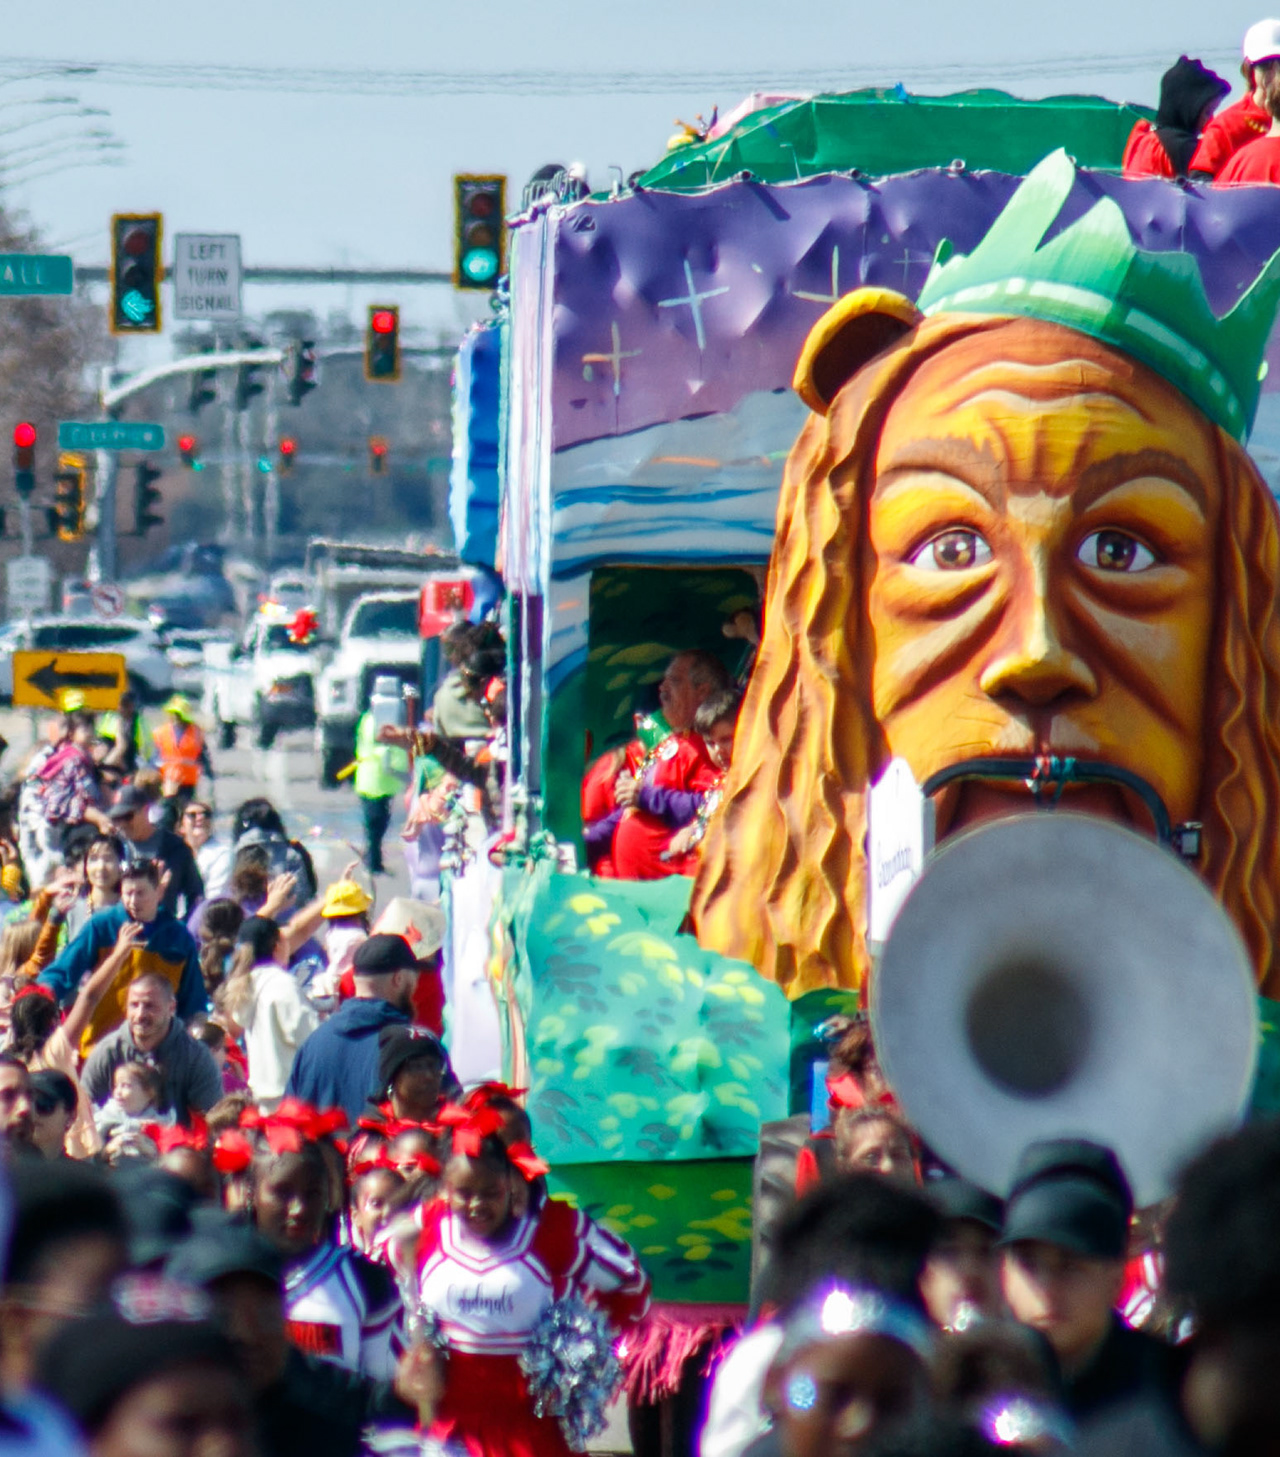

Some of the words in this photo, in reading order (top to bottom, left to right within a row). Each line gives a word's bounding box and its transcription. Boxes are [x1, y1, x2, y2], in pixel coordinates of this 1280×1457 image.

[189, 243, 225, 260] LEFT
[188, 267, 228, 286] TURN
[180, 295, 237, 311] SIGNAL
